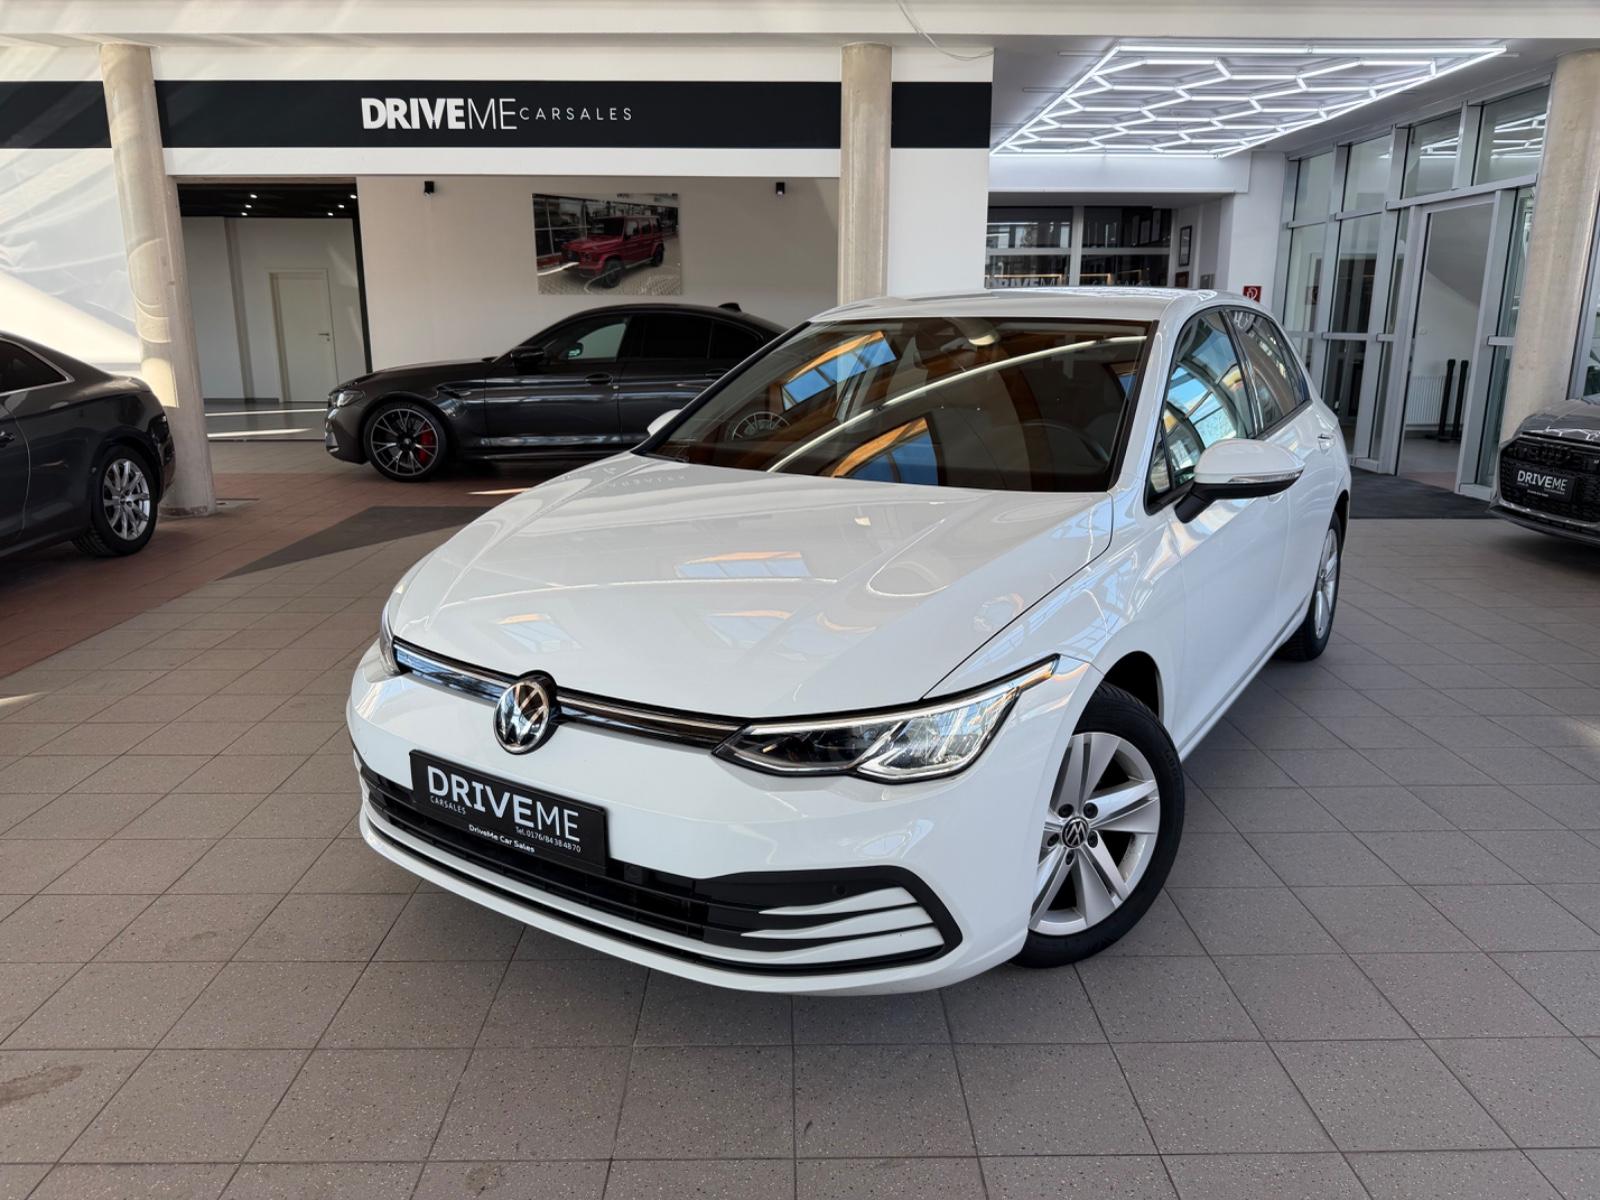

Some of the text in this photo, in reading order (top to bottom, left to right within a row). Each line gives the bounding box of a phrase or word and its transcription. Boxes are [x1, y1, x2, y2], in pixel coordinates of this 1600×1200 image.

[361, 97, 632, 130] DRIVEME CARSALES
[1517, 470, 1568, 491] DRIVEME
[427, 765, 580, 842] DRIVEME
[430, 795, 466, 815] CARSALES
[500, 835, 512, 846] Car
[514, 840, 535, 853] Sales
